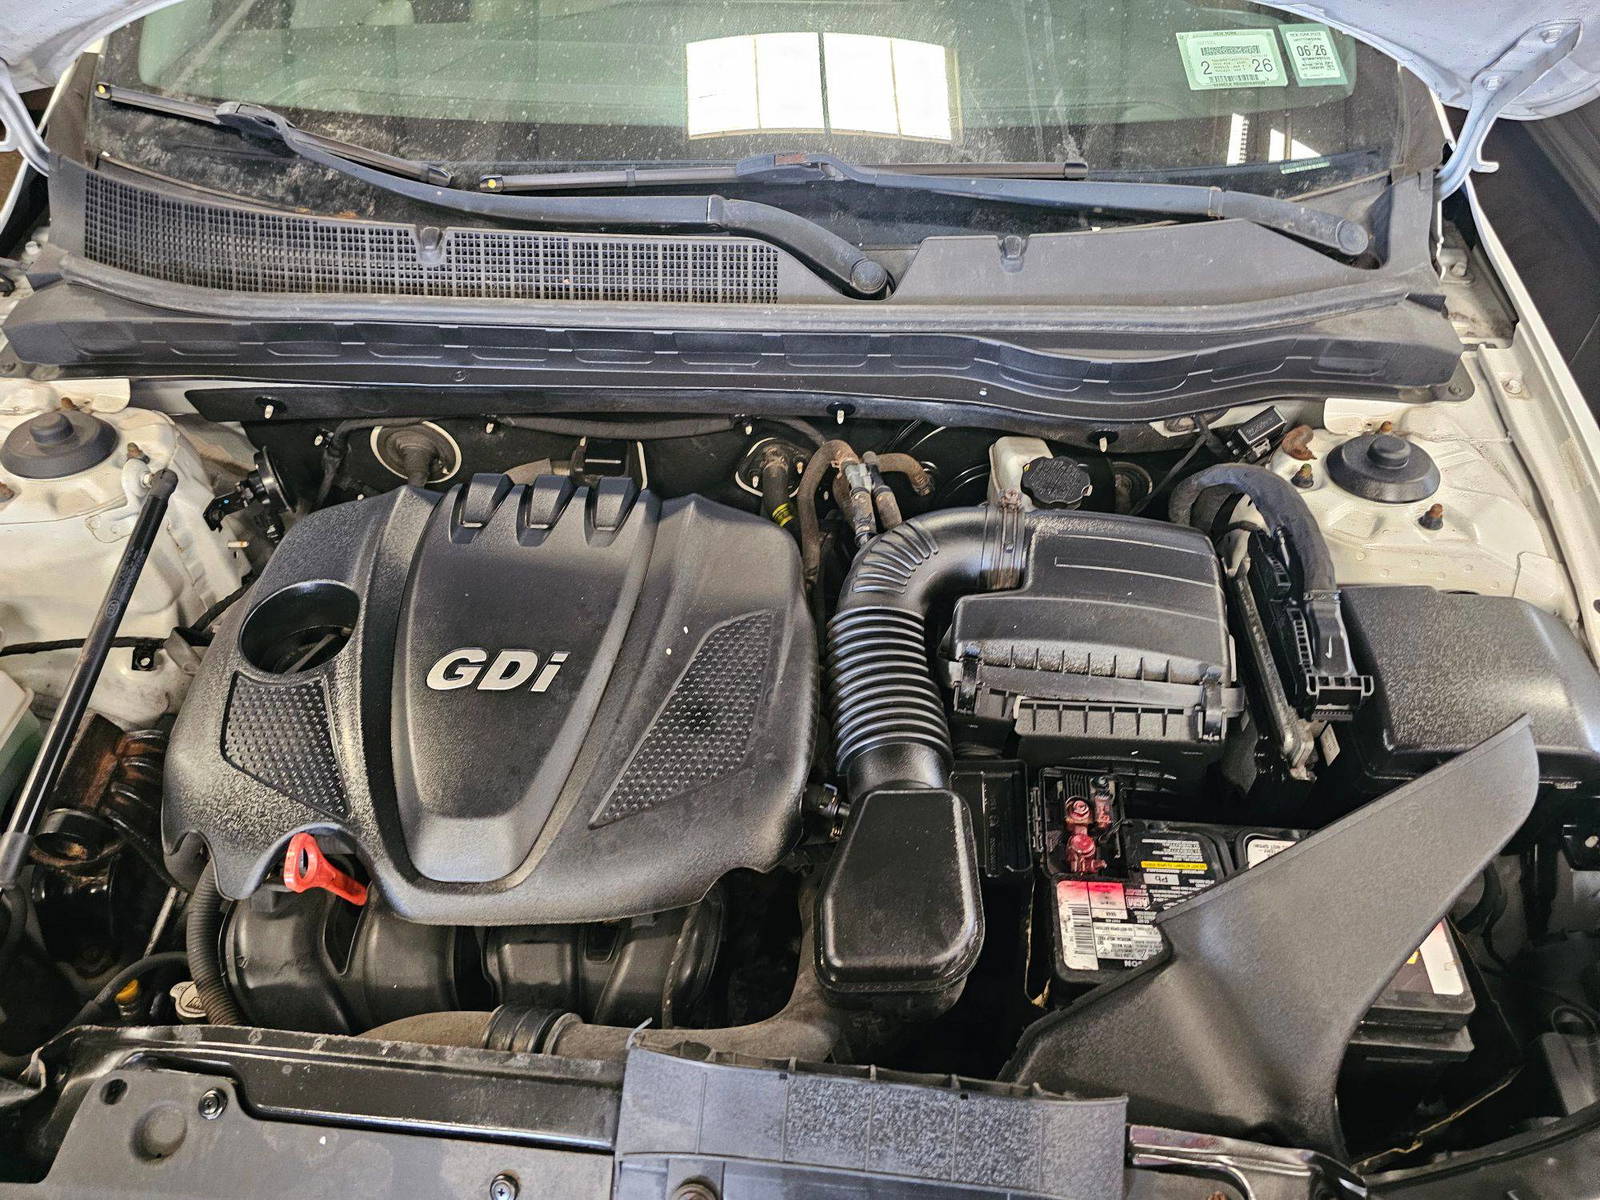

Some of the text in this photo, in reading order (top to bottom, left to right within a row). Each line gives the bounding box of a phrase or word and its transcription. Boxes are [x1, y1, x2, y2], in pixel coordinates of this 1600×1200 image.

[1296, 44, 1327, 57] 06 26
[1200, 60, 1213, 75] 2
[1251, 58, 1274, 73] 26
[426, 647, 572, 693] GDi
